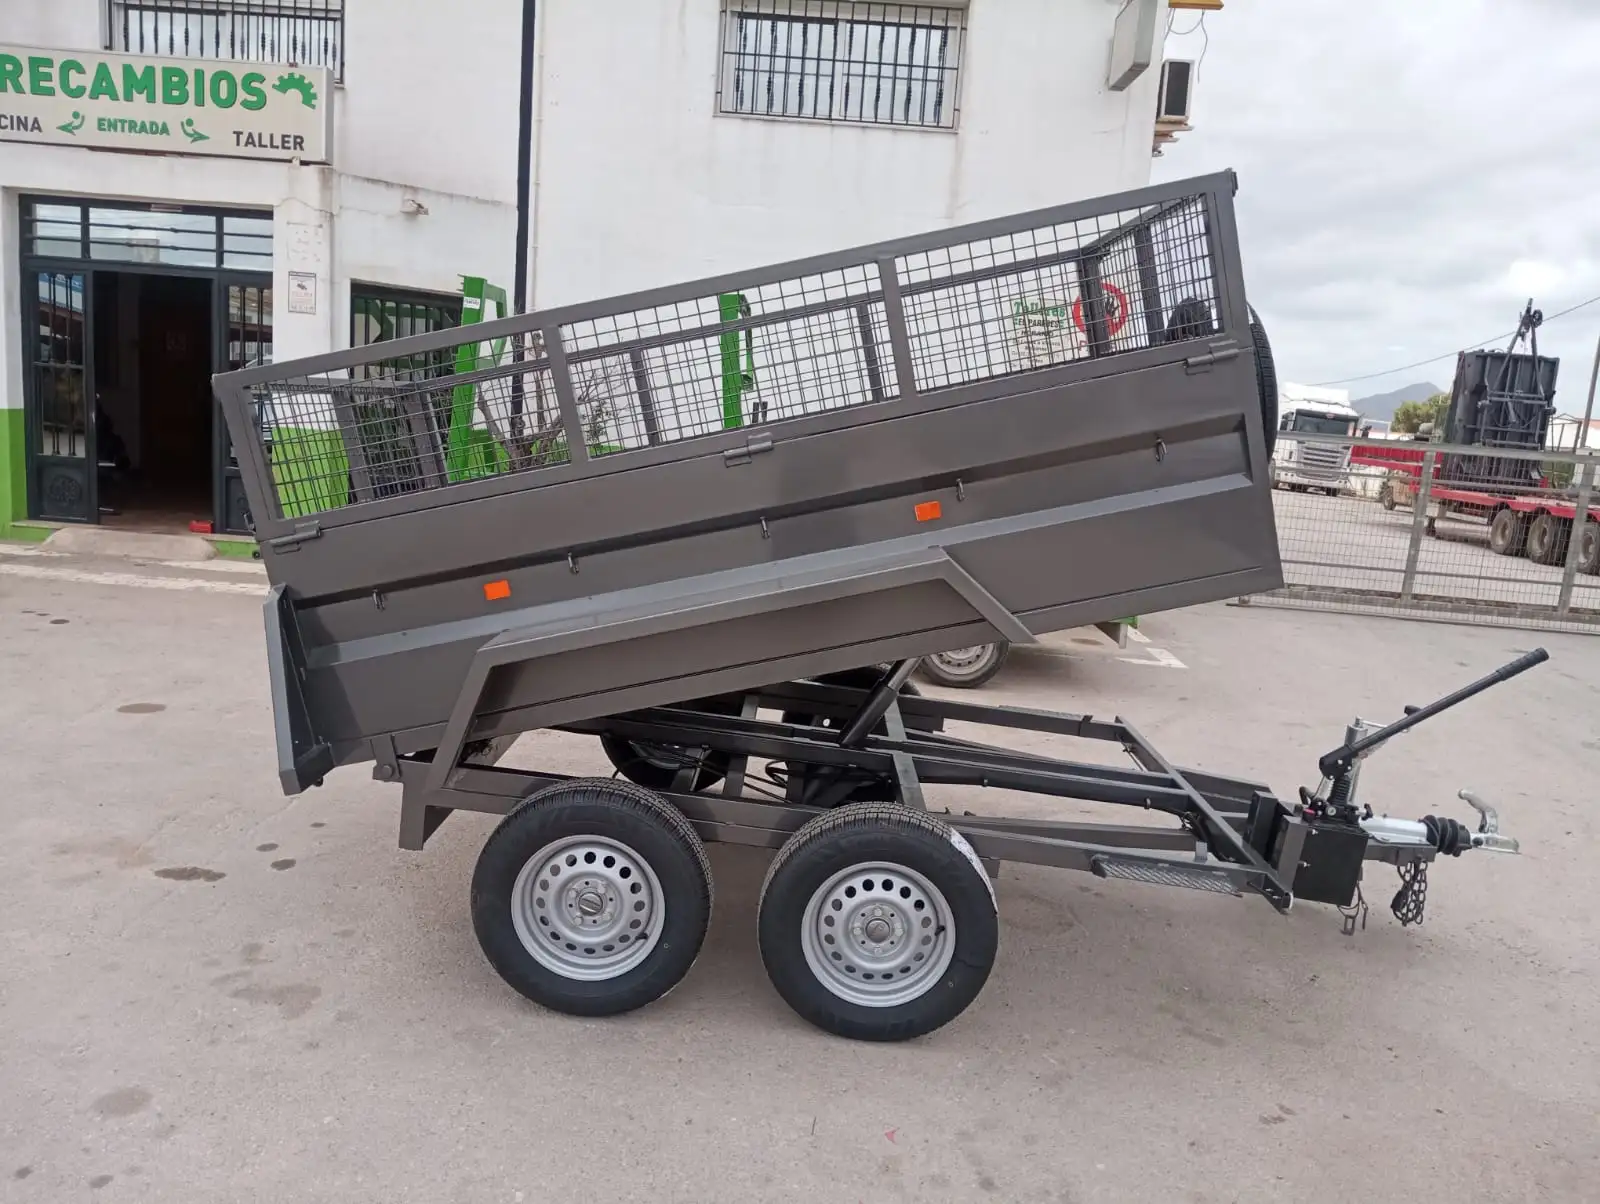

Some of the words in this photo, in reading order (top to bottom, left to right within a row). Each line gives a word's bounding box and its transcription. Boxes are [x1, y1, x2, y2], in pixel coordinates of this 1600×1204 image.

[0, 54, 267, 110] RECAMBIOS
[0, 114, 43, 133] CINA
[97, 117, 170, 136] ENTRADA
[232, 130, 304, 151] TALLER
